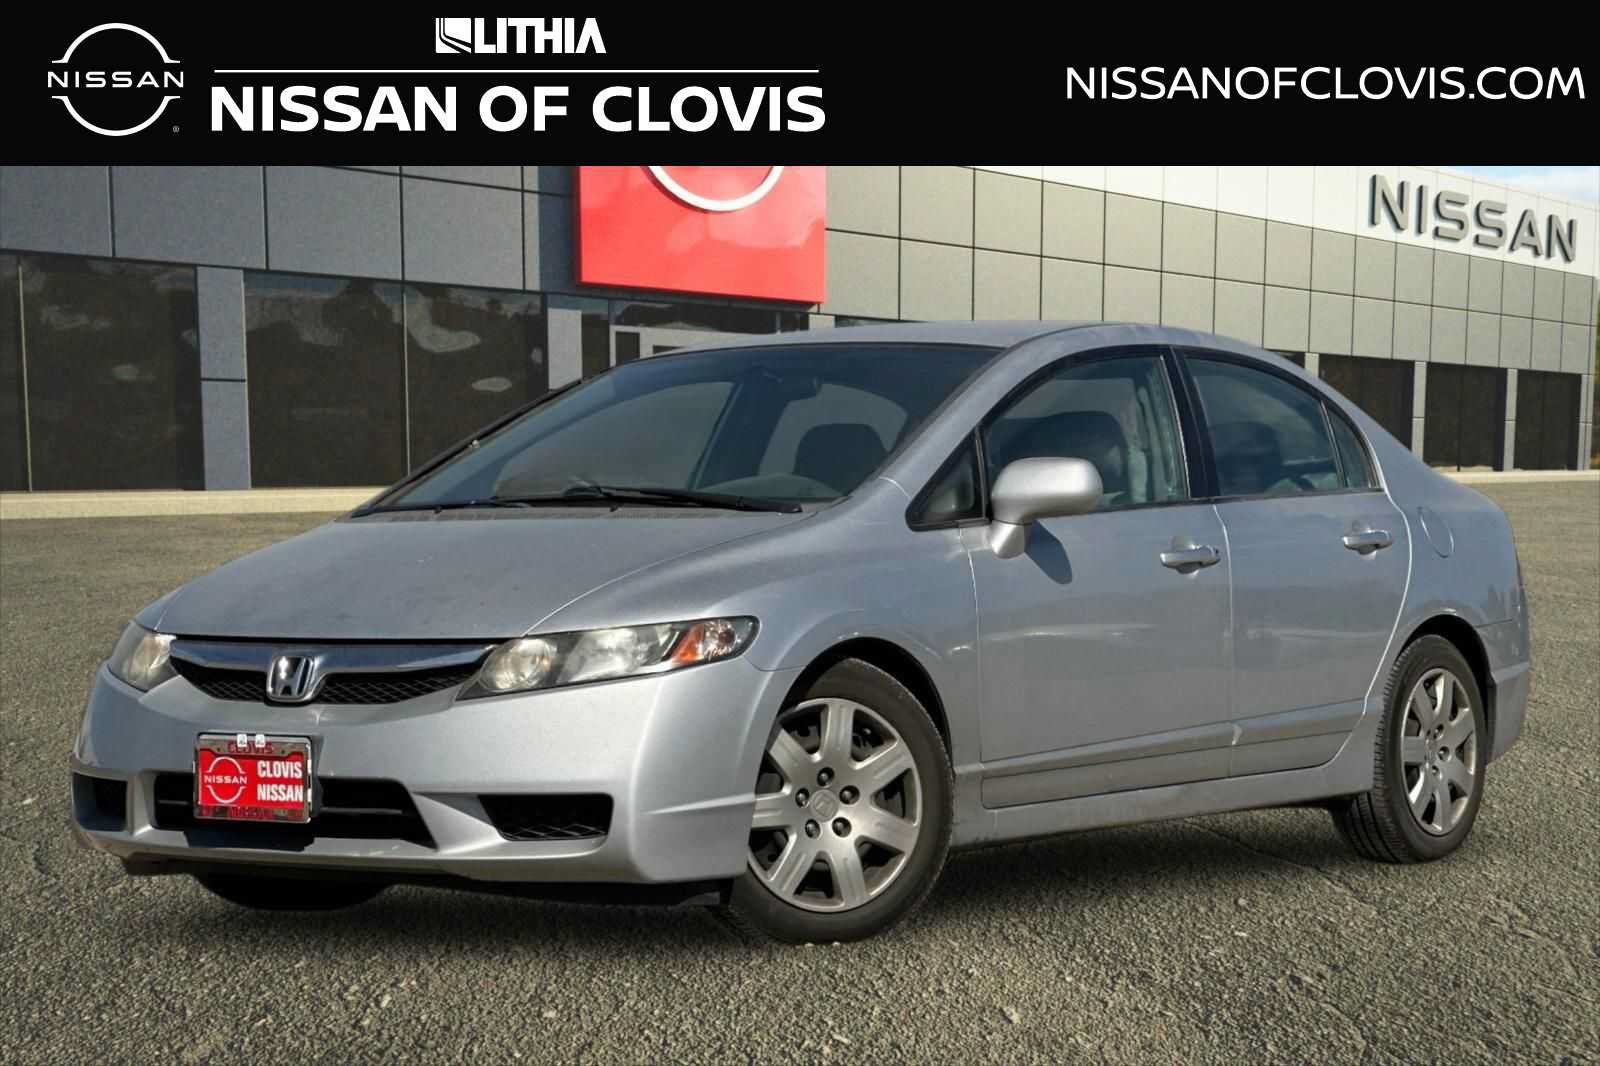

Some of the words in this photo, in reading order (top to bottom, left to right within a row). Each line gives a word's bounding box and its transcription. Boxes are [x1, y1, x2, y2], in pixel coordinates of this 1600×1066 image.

[1369, 174, 1578, 263] NISSAN
[204, 774, 248, 784] NISSAN
[257, 760, 303, 779] CLOVIS
[257, 784, 304, 803] NISSAN
